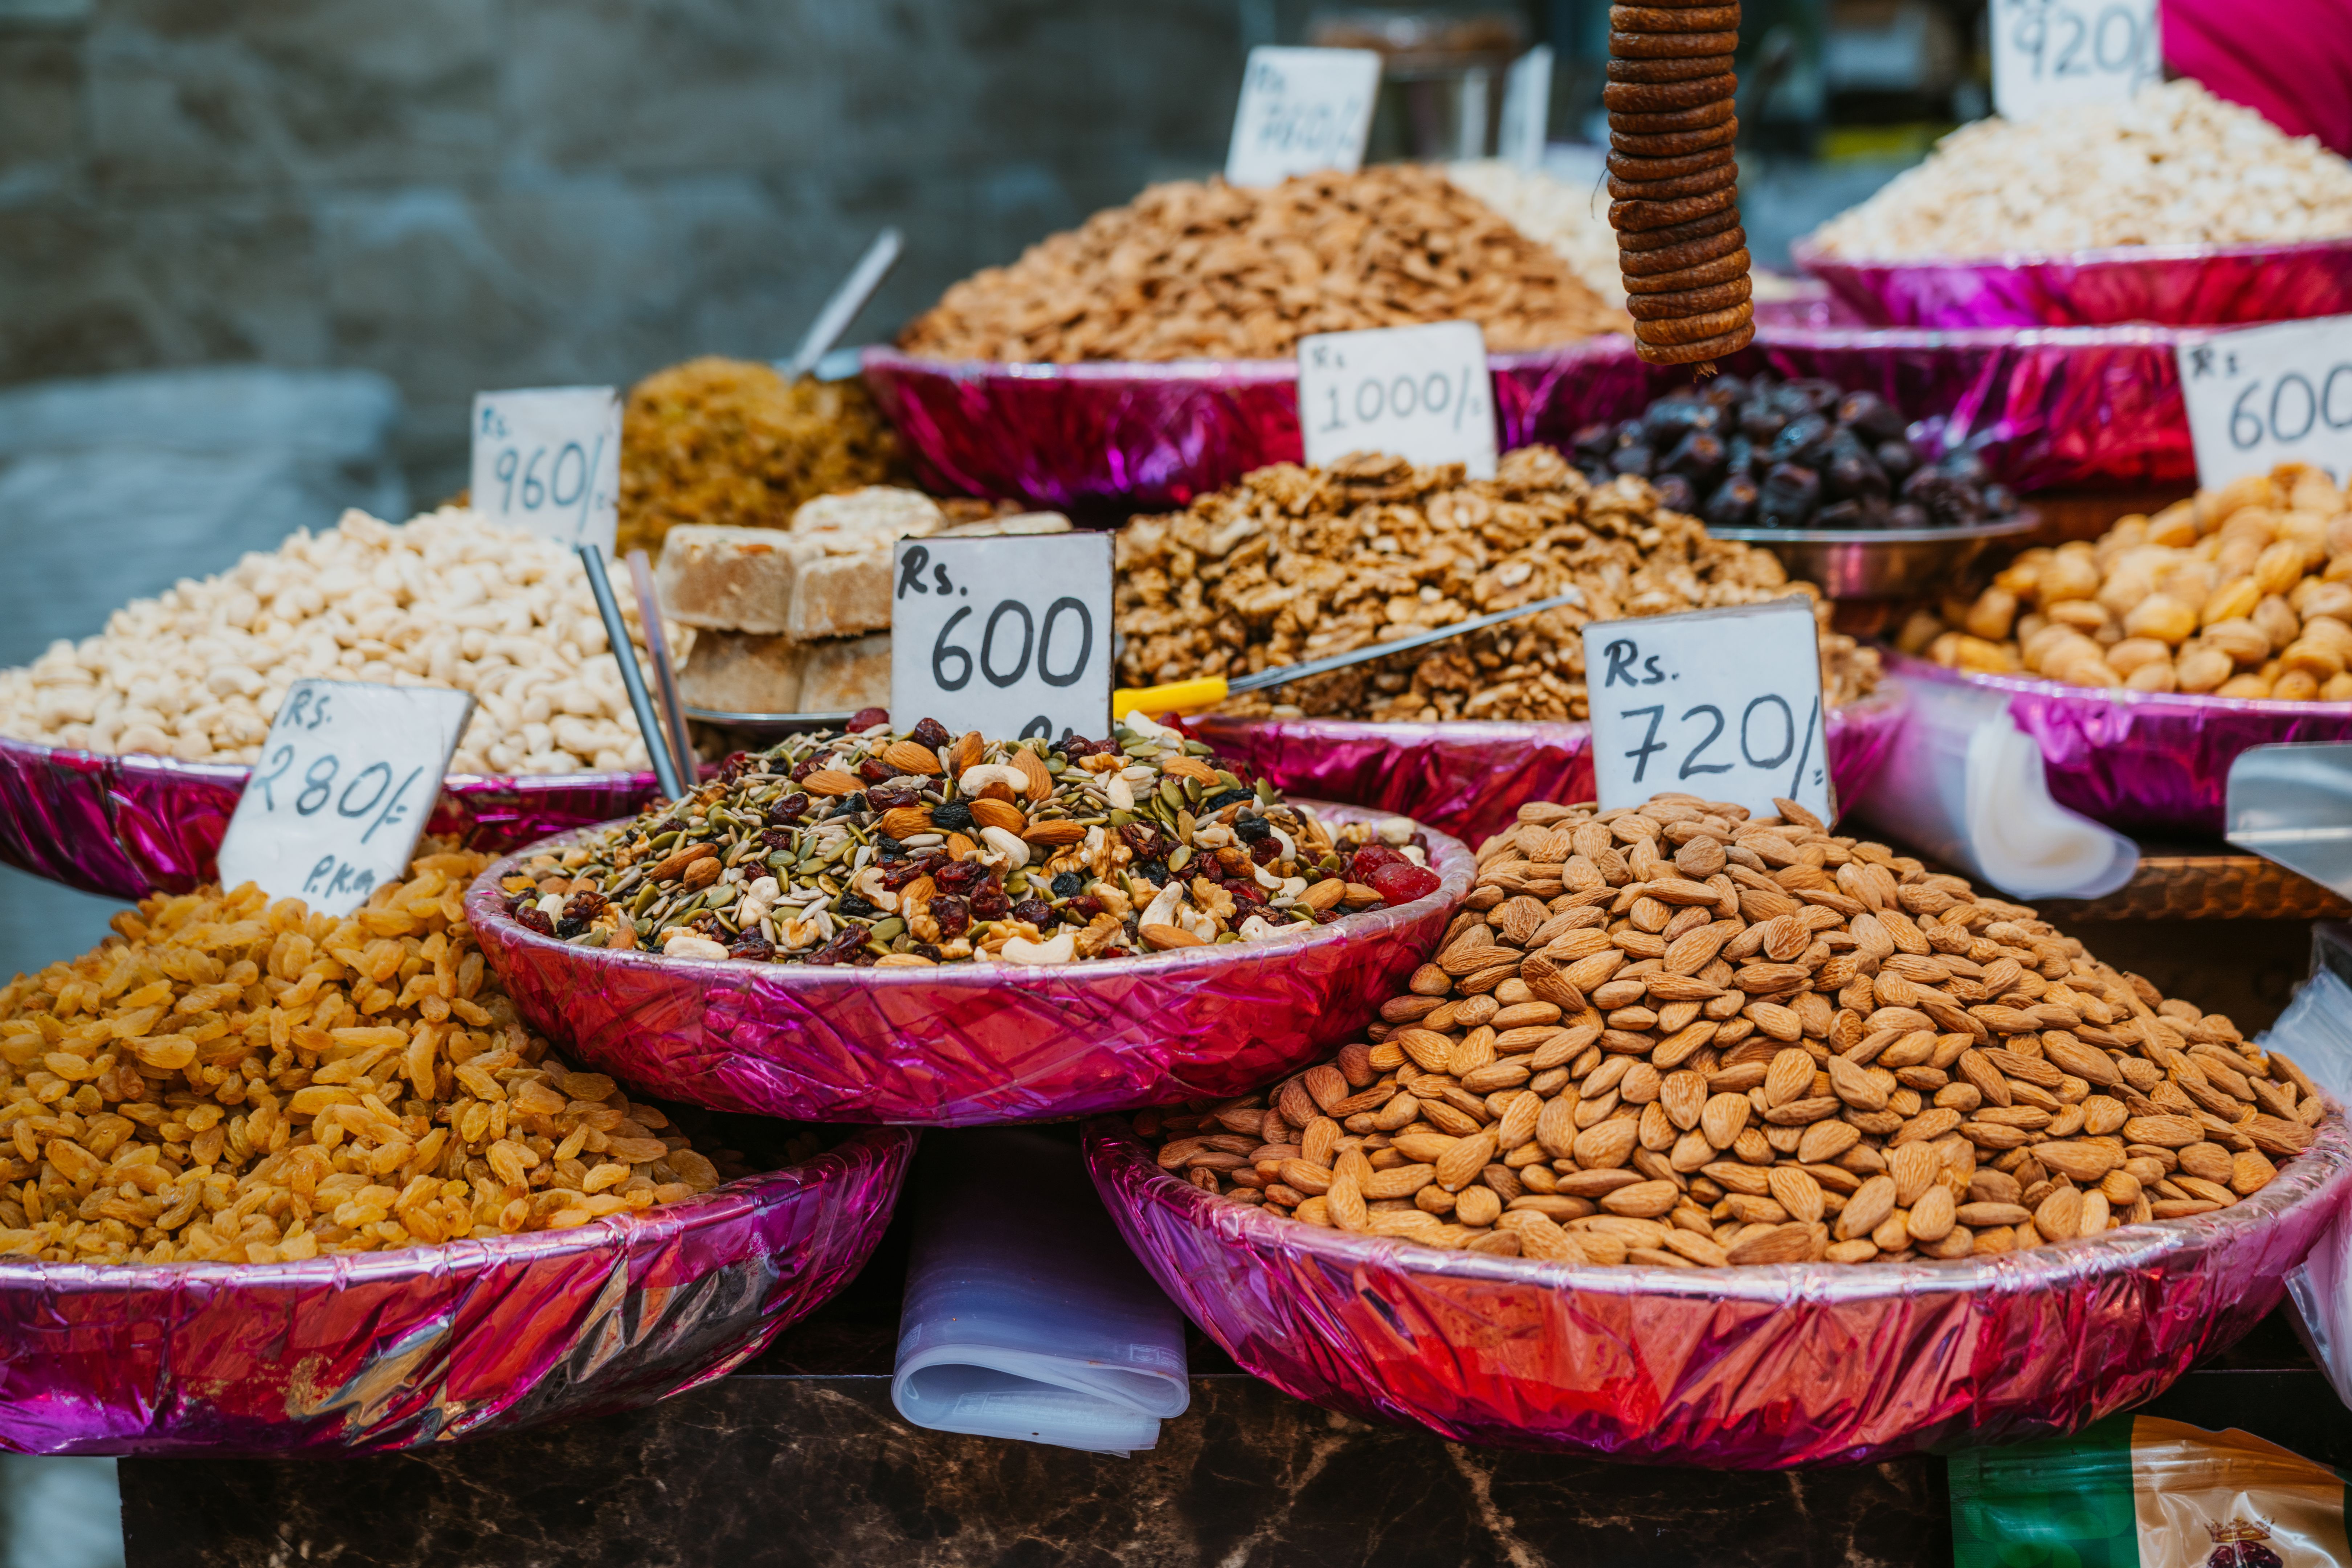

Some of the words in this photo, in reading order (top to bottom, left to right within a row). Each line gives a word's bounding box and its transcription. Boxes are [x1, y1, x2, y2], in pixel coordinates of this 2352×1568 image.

[898, 545, 968, 600] Rs.
[932, 597, 1093, 691] 600
[1604, 639, 1680, 688] Rs.
